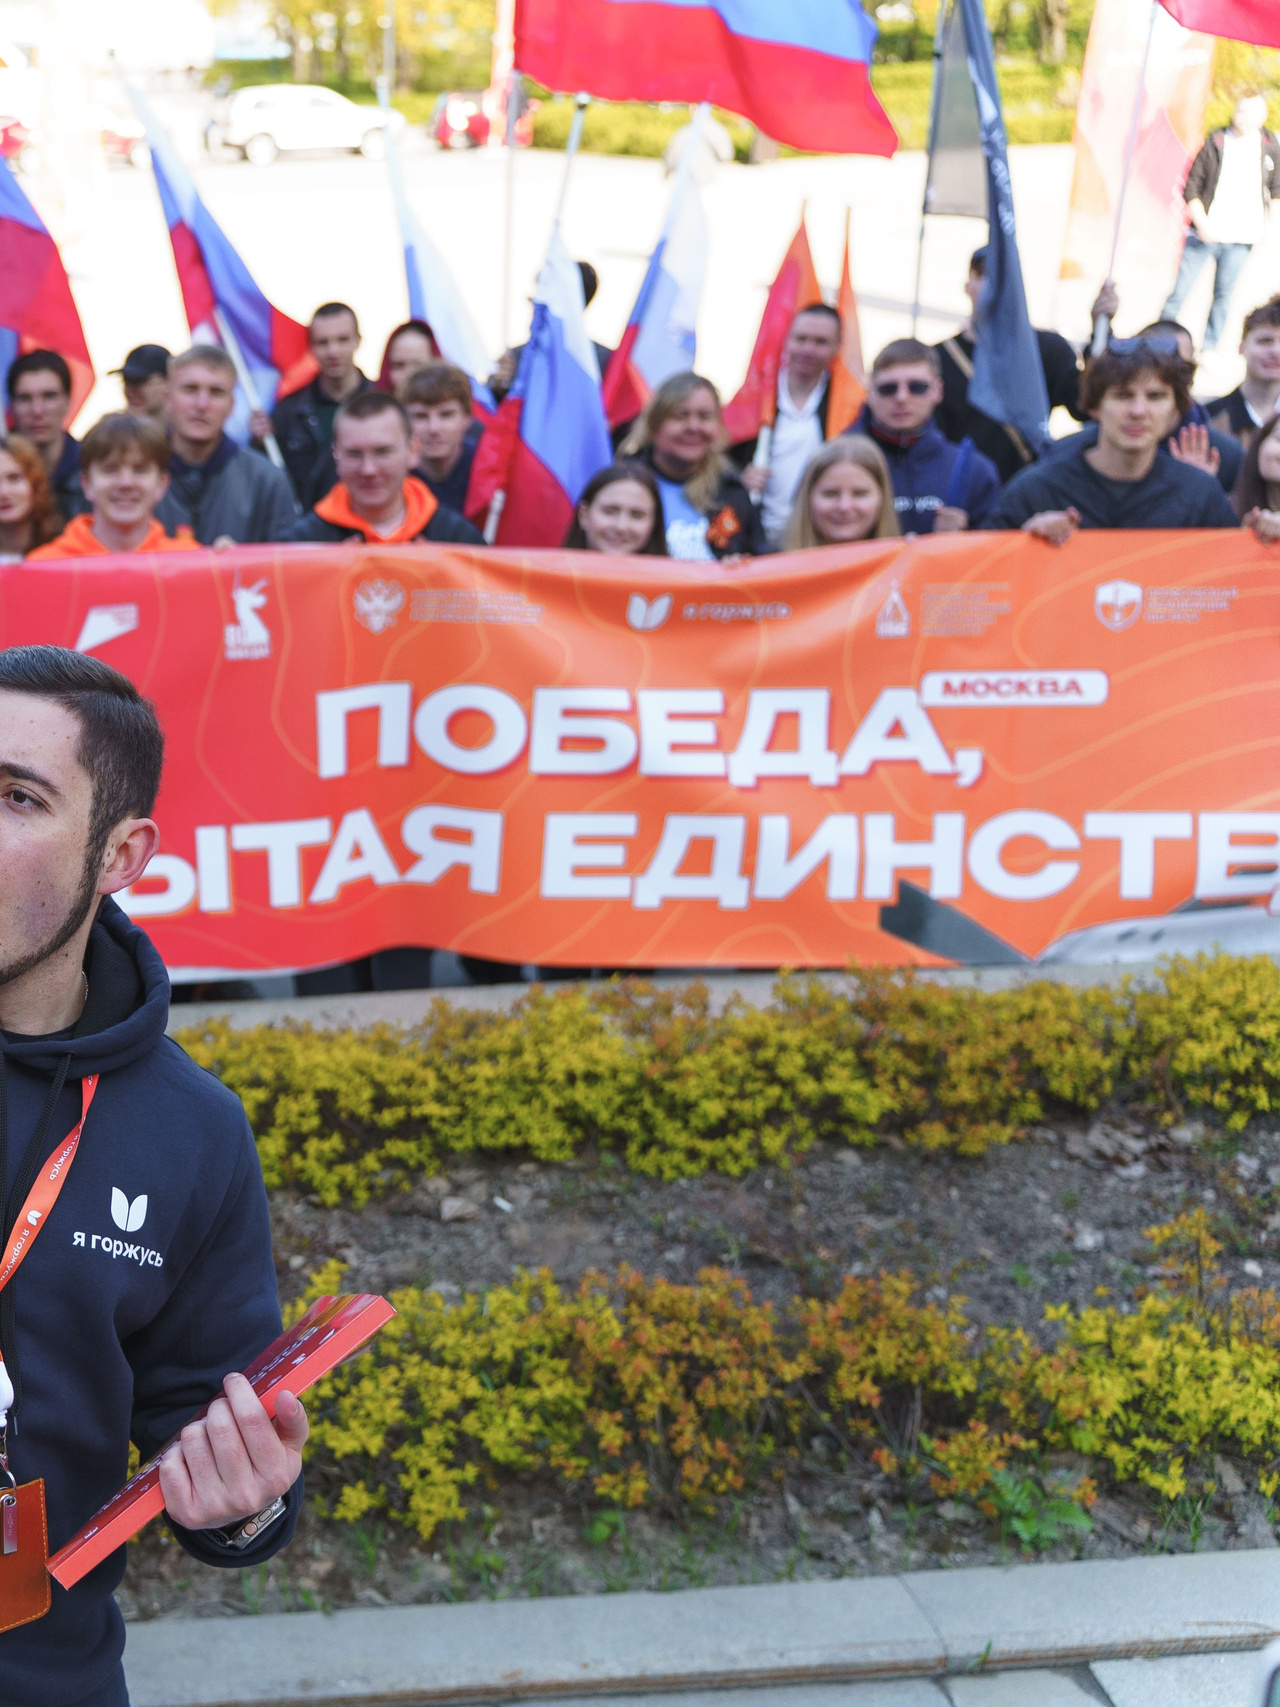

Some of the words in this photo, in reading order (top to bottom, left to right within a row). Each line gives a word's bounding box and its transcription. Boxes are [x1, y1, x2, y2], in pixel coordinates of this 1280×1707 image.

[942, 678, 1085, 698] МОСКВА
[316, 681, 984, 787] ПОБЕДА,
[22, 1228, 30, 1237] я
[72, 1231, 86, 1248] я
[91, 1236, 164, 1268] горжусь
[0, 1236, 26, 1281] горжусь
